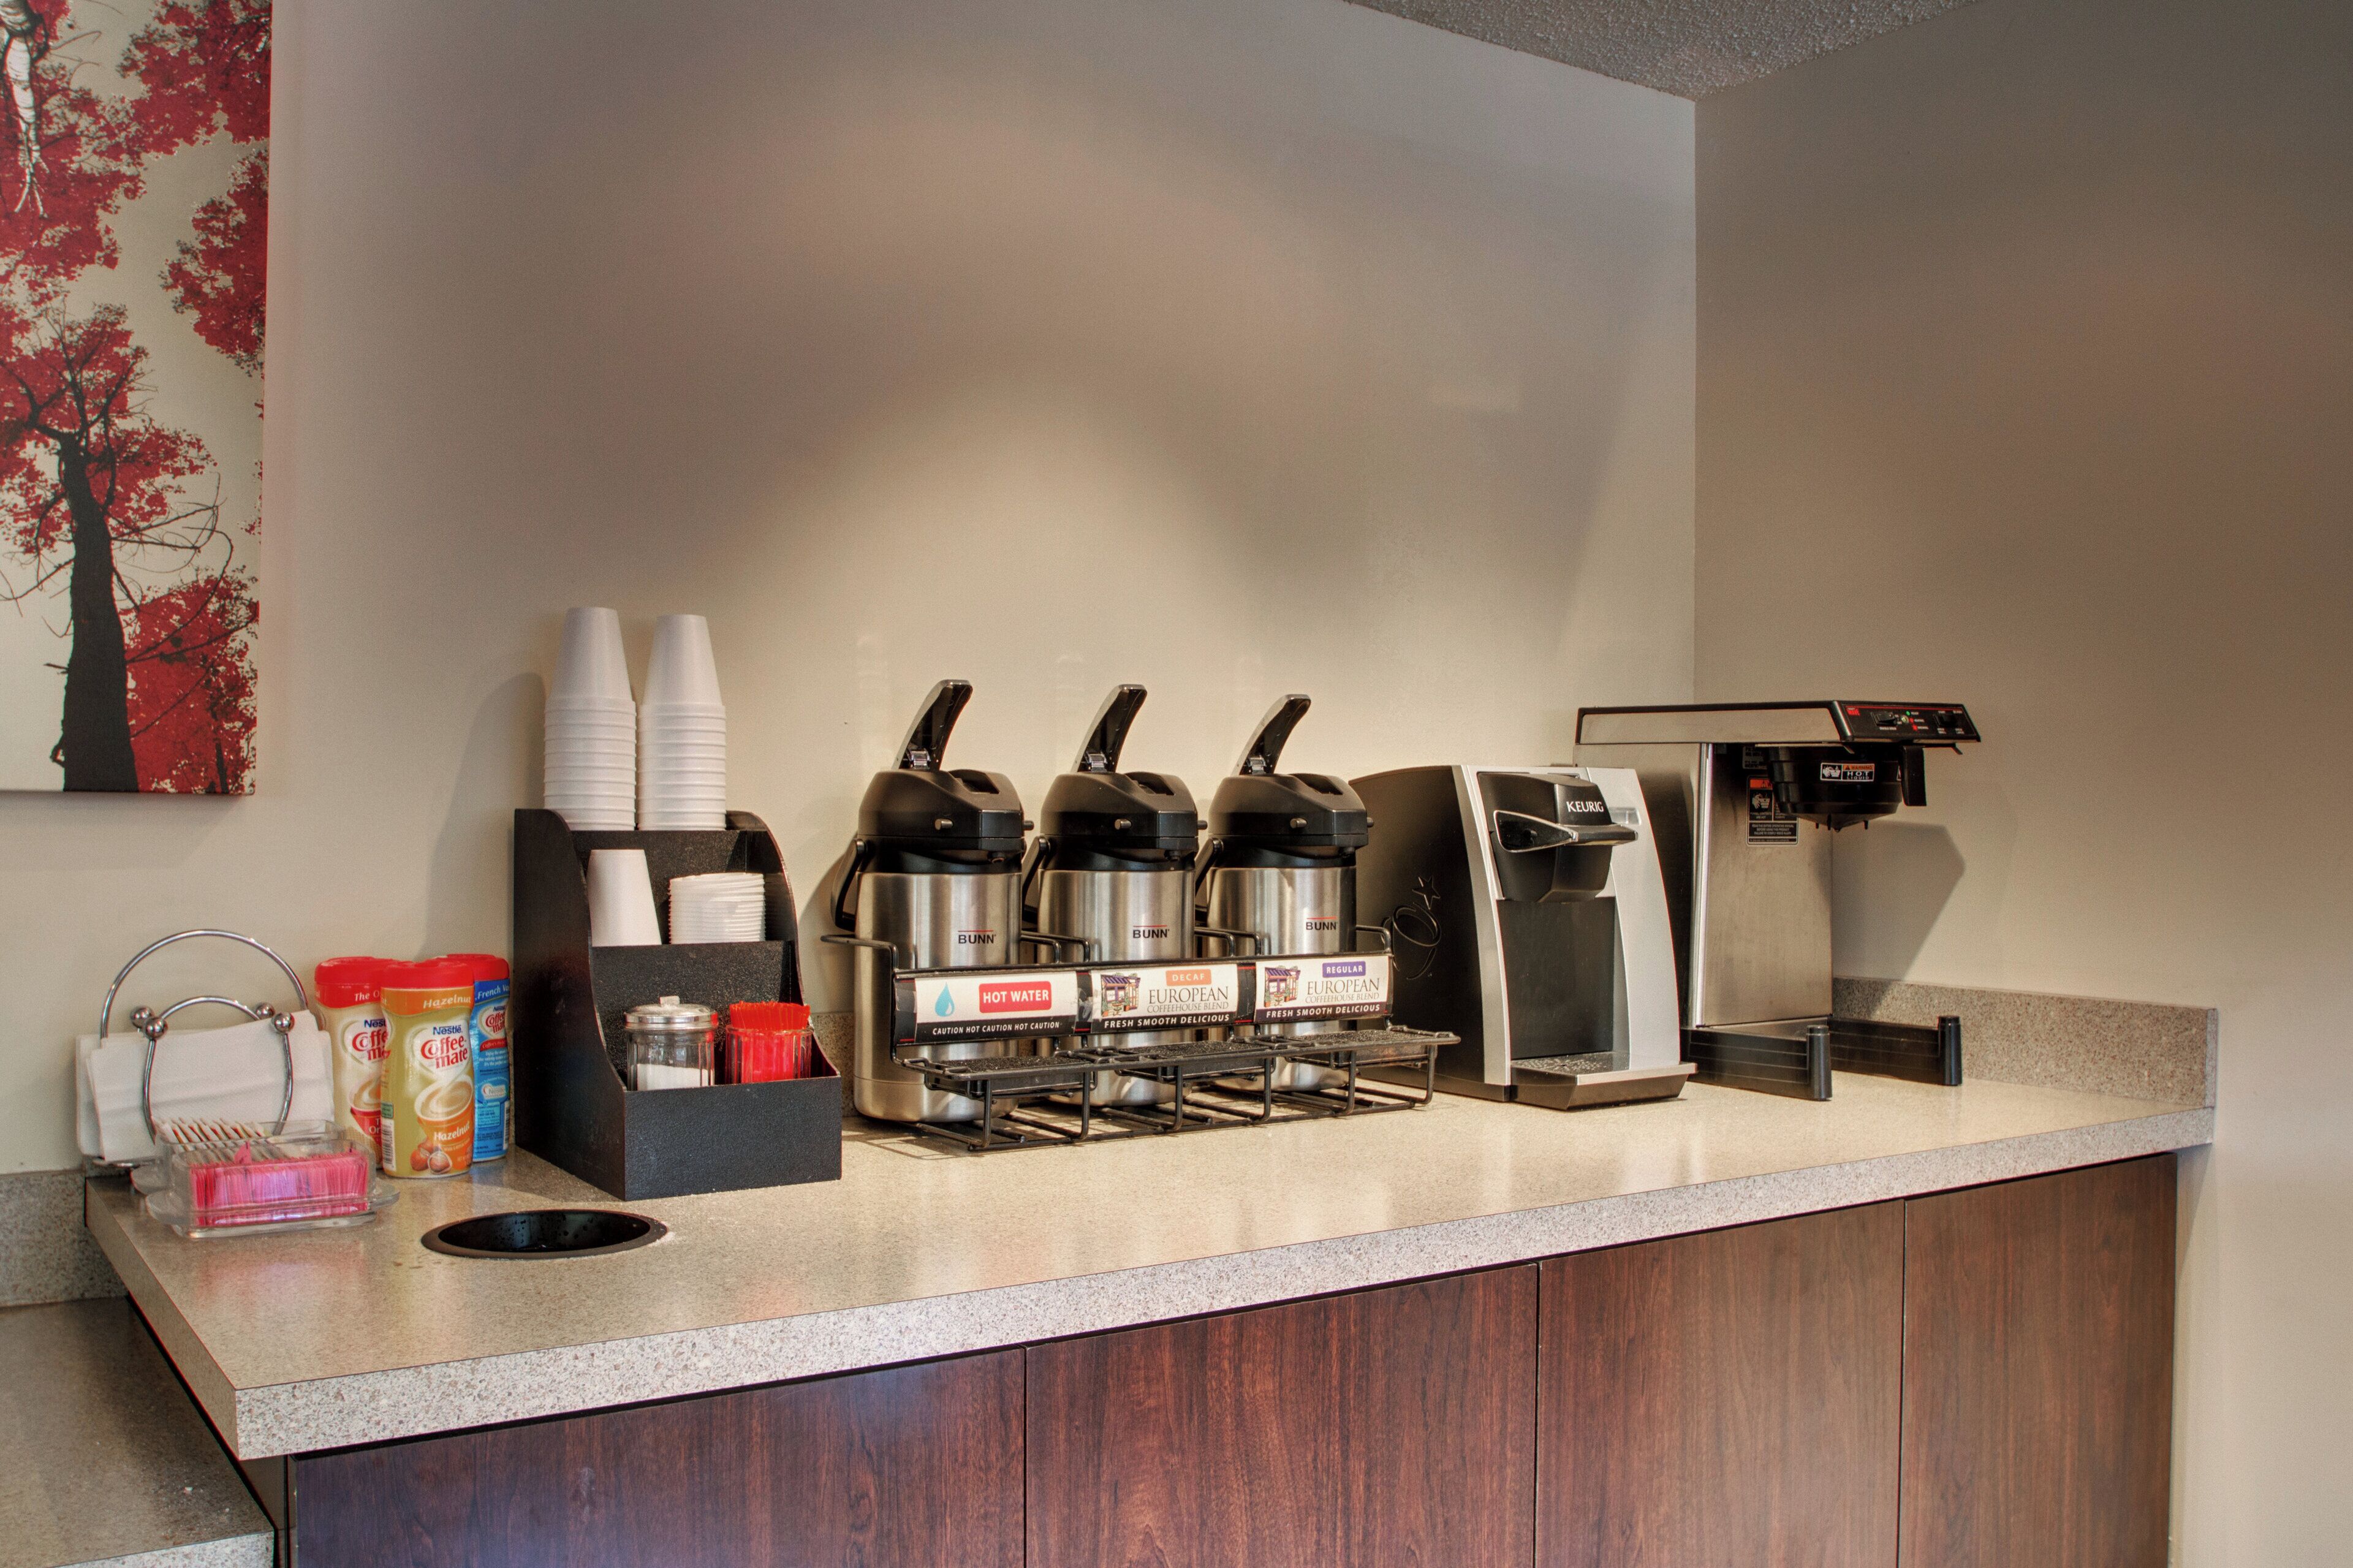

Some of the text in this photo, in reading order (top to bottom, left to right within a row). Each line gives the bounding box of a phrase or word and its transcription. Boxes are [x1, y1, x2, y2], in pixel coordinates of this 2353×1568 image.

[1566, 801, 1604, 812] KEURIG
[1306, 922, 1336, 930] BUNN
[958, 934, 995, 944] BUNN
[1132, 929, 1167, 939] BUNN
[1326, 965, 1363, 974] REGULAR
[1172, 973, 1205, 982] DECAF
[478, 985, 501, 1000] French
[1307, 978, 1380, 995] EUROPEAN
[354, 992, 370, 1002] The
[983, 989, 1050, 1004] HOT WATER
[1149, 987, 1229, 1004] EUROPEAN
[1305, 992, 1379, 1004] COFFEEHOUSE BLEND
[1147, 1001, 1229, 1013] COFFEEHOUSE BLEND
[1266, 1004, 1380, 1018] FRESH SMOOTH DELICIOUS
[1104, 1014, 1230, 1029] FRESH SMOOTH DELICIOUS
[933, 1027, 964, 1036] CAUTION
[436, 1047, 468, 1069] mate
[434, 1121, 470, 1141] Hazelnut
